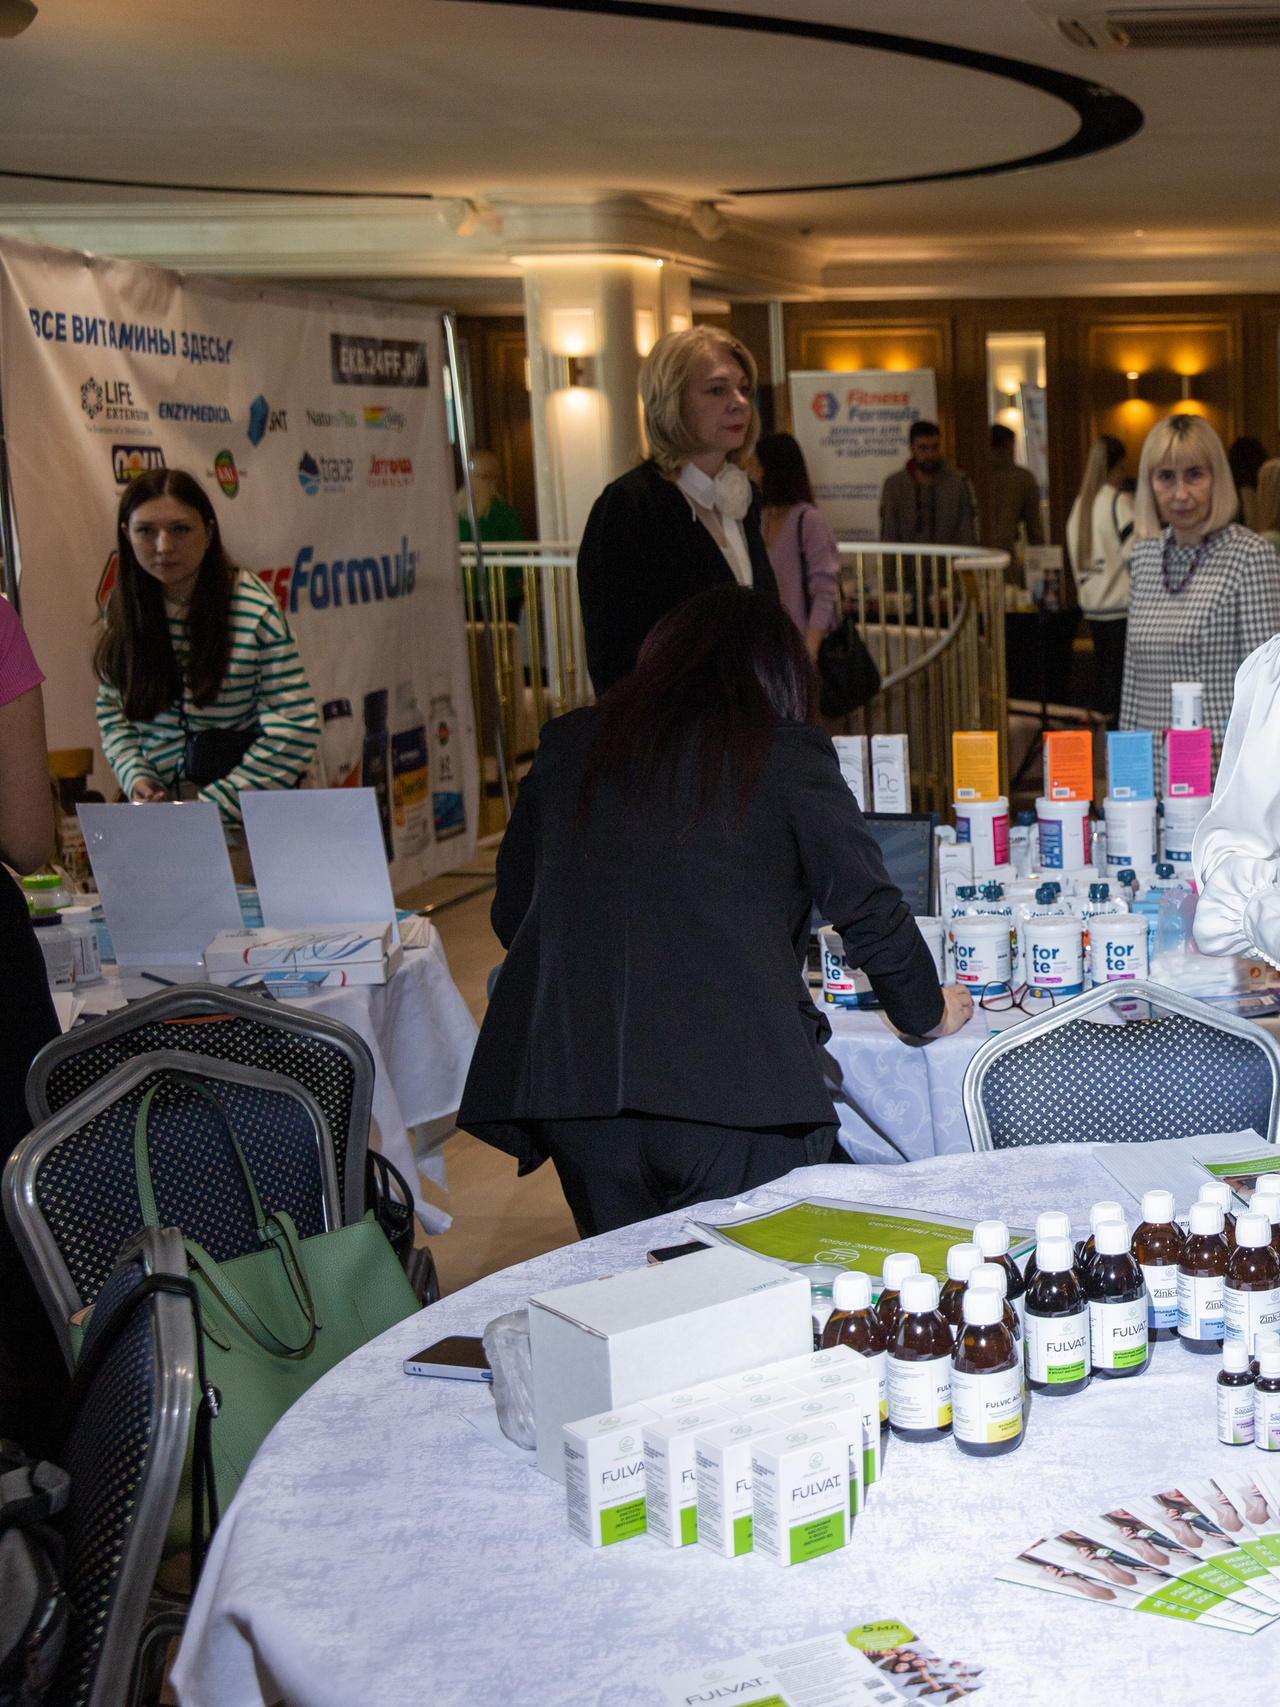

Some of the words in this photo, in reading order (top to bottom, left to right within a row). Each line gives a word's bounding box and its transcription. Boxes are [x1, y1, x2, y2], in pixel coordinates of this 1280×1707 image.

[29, 308, 67, 342] ВСЕ
[72, 315, 176, 356] ВИТАМИНЫ
[181, 331, 233, 364] ЗДЕСЬ!
[105, 379, 134, 406] LIFE
[158, 402, 232, 424] ENZYMEDICA
[954, 941, 976, 958] for
[1032, 944, 1060, 960] for
[1105, 941, 1134, 957] for
[955, 958, 968, 971] te
[1033, 958, 1052, 974] te
[1106, 957, 1126, 971] te
[826, 965, 842, 981] te
[819, 1238, 849, 1247] LOGOS
[851, 1242, 896, 1255] ORGANIC
[1154, 1287, 1178, 1298] Zink-
[1205, 1300, 1224, 1310] Zink
[1113, 1320, 1147, 1338] FULVAT
[1046, 1336, 1086, 1352] FULVAT
[937, 1383, 952, 1393] FULV
[985, 1398, 1011, 1409] FULVIC
[602, 1461, 645, 1485] FULVA
[792, 1474, 841, 1501] FULVAT
[862, 1623, 875, 1633] 5
[685, 1676, 765, 1706] FULVAT
